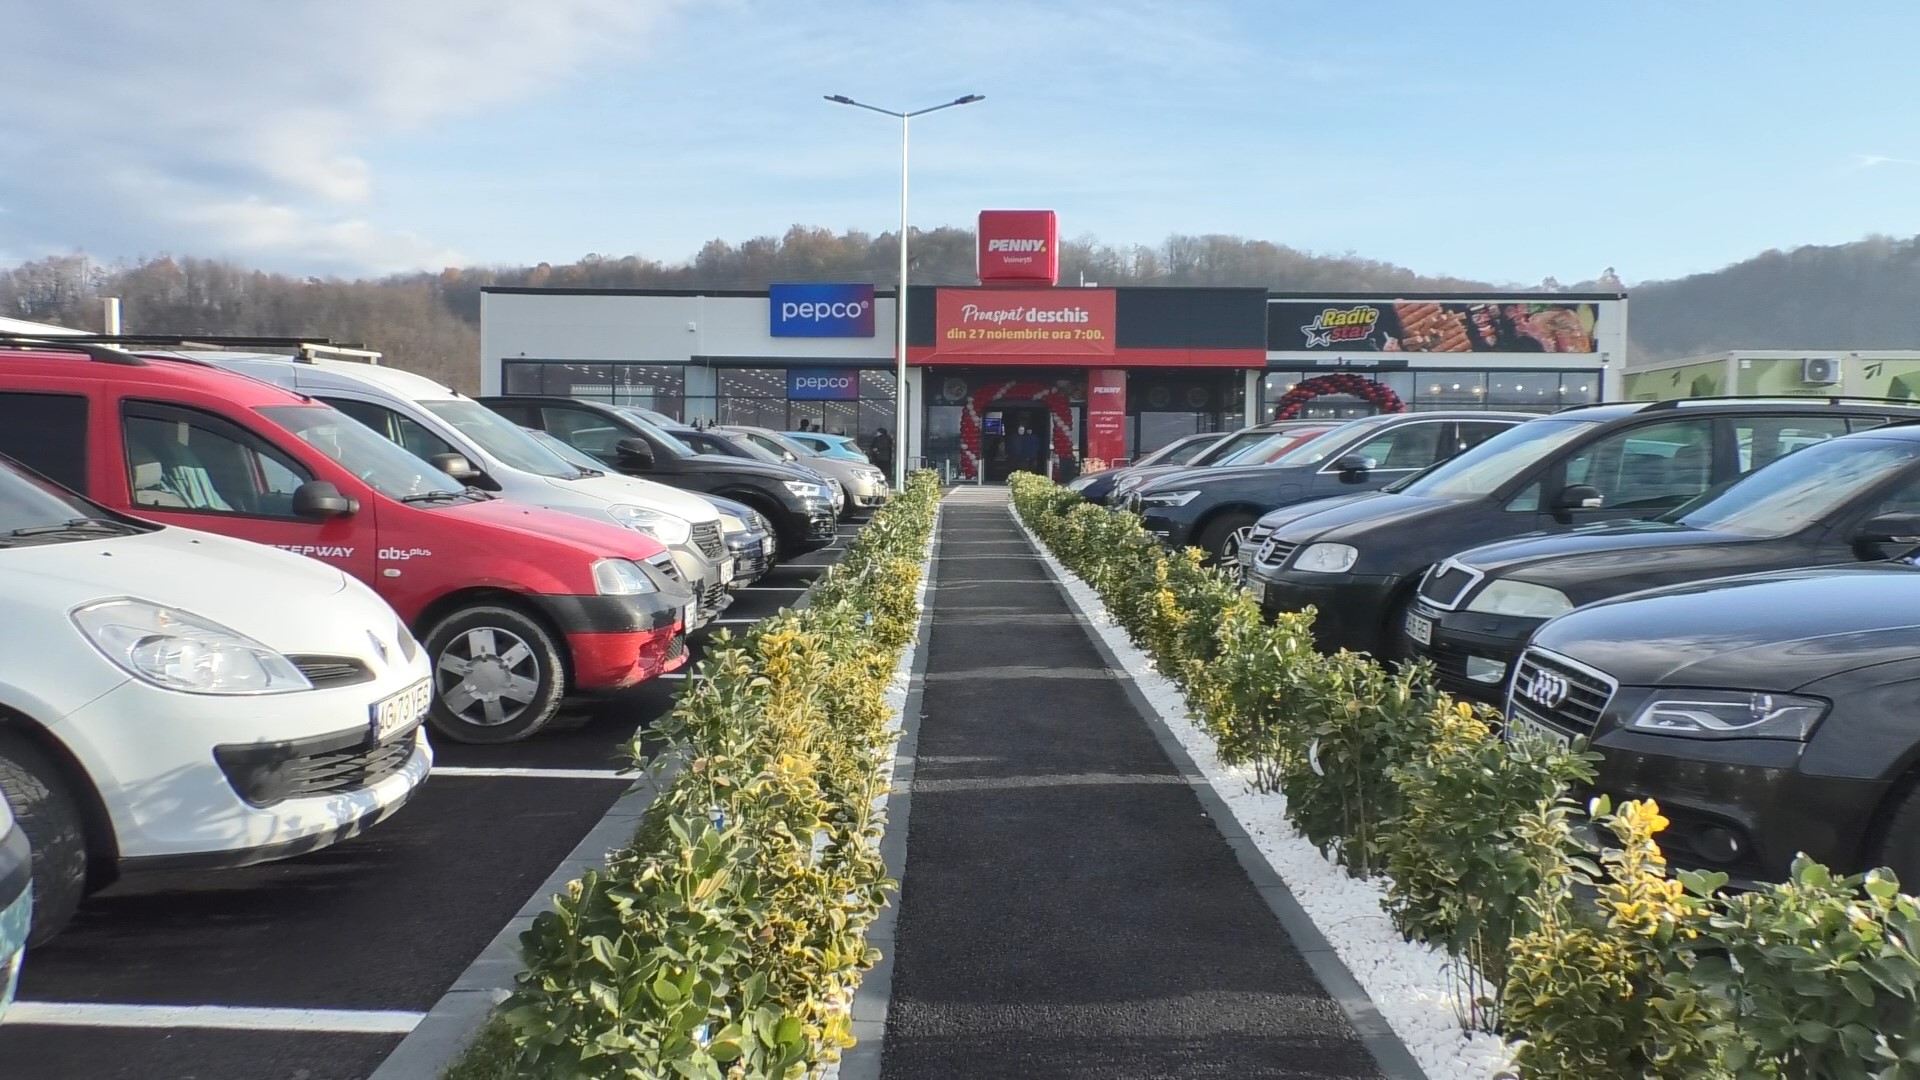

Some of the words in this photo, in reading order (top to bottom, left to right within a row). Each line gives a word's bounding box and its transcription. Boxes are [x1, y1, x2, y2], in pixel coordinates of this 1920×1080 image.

[1026, 308, 1088, 323] deschis
[1322, 308, 1376, 326] Radic
[947, 328, 966, 340] din
[969, 329, 985, 340] 27
[986, 328, 1050, 340] noiembrie
[1052, 330, 1072, 340] ora
[1074, 329, 1105, 340] 7:00.
[1330, 326, 1371, 339] star
[267, 544, 354, 557] TEPWAY
